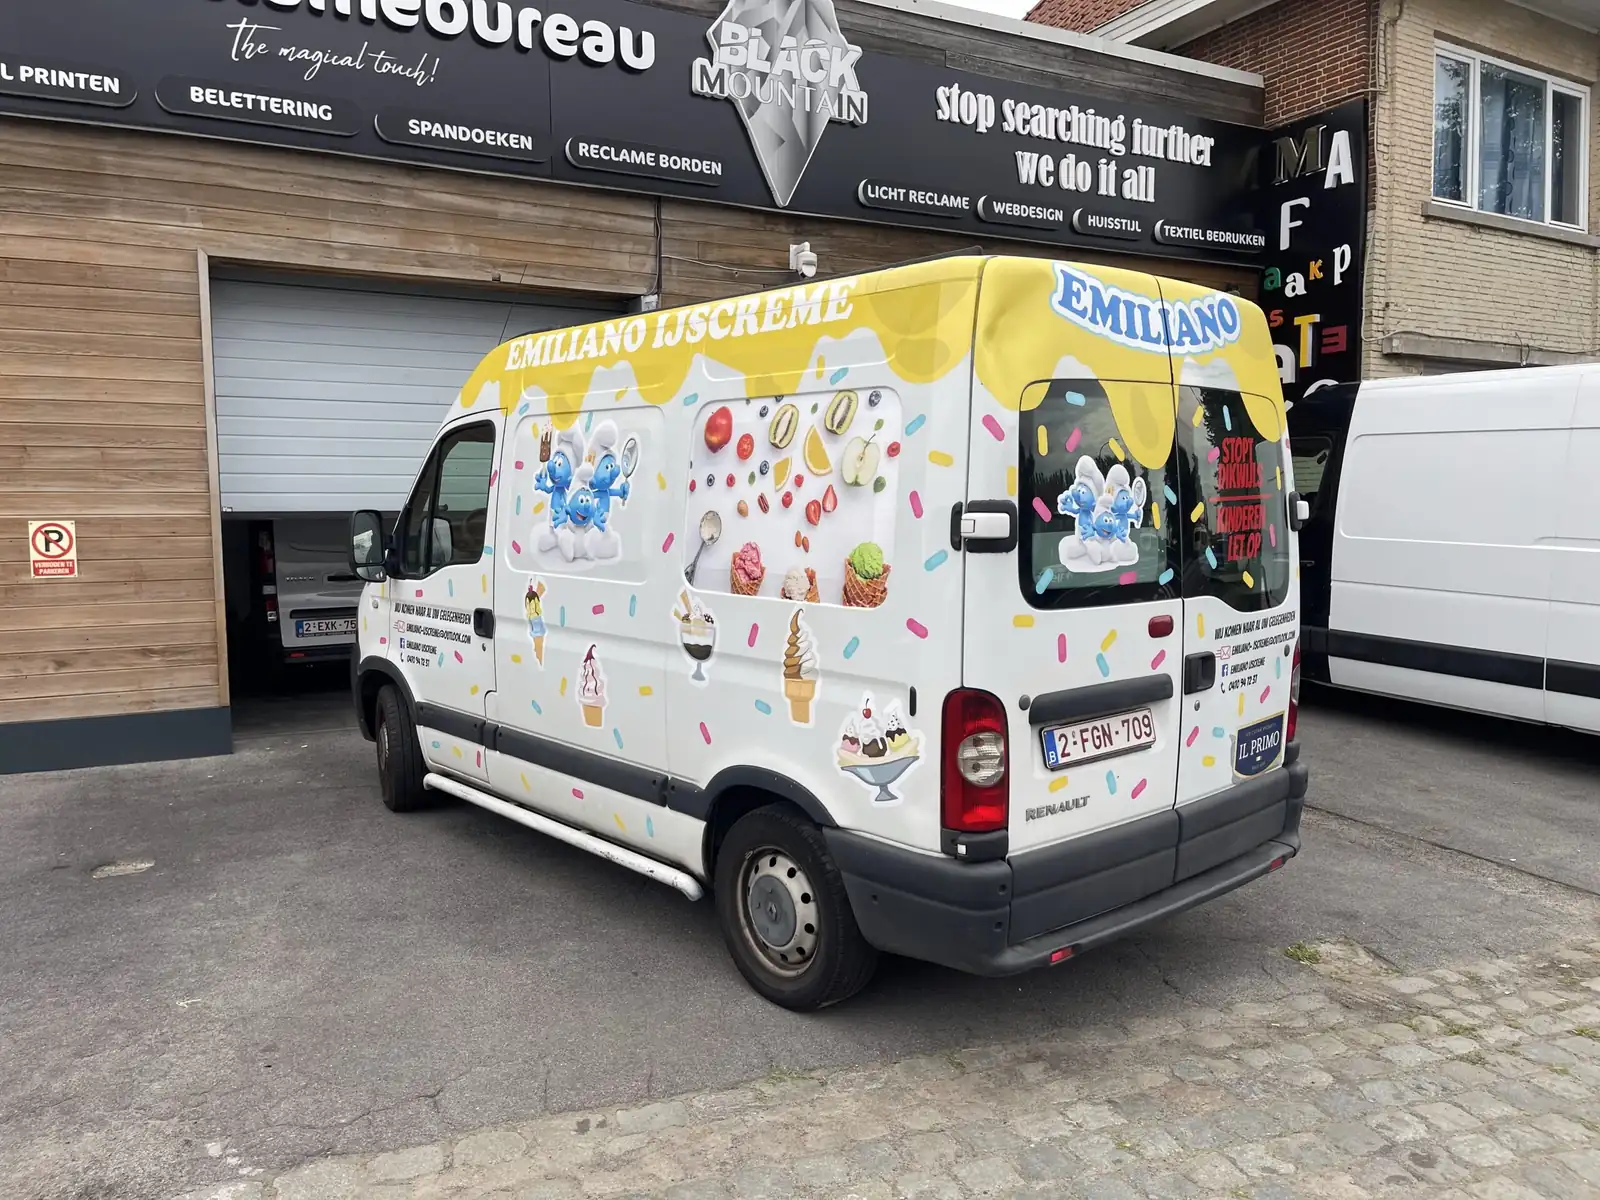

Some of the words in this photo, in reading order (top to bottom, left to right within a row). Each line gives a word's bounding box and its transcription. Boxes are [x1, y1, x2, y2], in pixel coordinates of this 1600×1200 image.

[279, 41, 368, 80] magical
[368, 50, 440, 87] touch!
[719, 20, 861, 92] BLACK
[19, 65, 120, 95] PRINTEN
[698, 63, 865, 124] MOUNTAIN
[189, 86, 333, 121] BELETTERING
[408, 119, 533, 151] SPANDOEKEN
[936, 83, 995, 133] stop
[1002, 99, 1126, 156] searching
[1131, 118, 1215, 167] further
[578, 142, 656, 167] RECLAME
[659, 154, 723, 177] BORDEN
[1015, 150, 1055, 187] we
[1059, 153, 1092, 193] do
[1097, 158, 1117, 197] it
[1122, 165, 1156, 203] all
[867, 184, 906, 202] LICHT
[909, 190, 970, 210] RECLAME
[993, 201, 1064, 222] WEBDESIGN
[1087, 214, 1142, 233] HUISSTIJL
[1164, 225, 1205, 241] TEXTIEL
[1206, 230, 1266, 247] BEDRUKKEN
[1057, 269, 1238, 346] EMILIANO
[504, 316, 647, 371] EMILIANO
[651, 279, 859, 349] IJSCREME
[1222, 437, 1256, 464] STOPT
[1216, 504, 1267, 533] KINDEREN
[1227, 534, 1245, 561] LET
[1246, 532, 1263, 558] OP
[1048, 751, 1057, 764] B
[1238, 743, 1249, 761] IL
[1250, 730, 1280, 756] PRIMO
[1025, 795, 1091, 823] RENAULT
